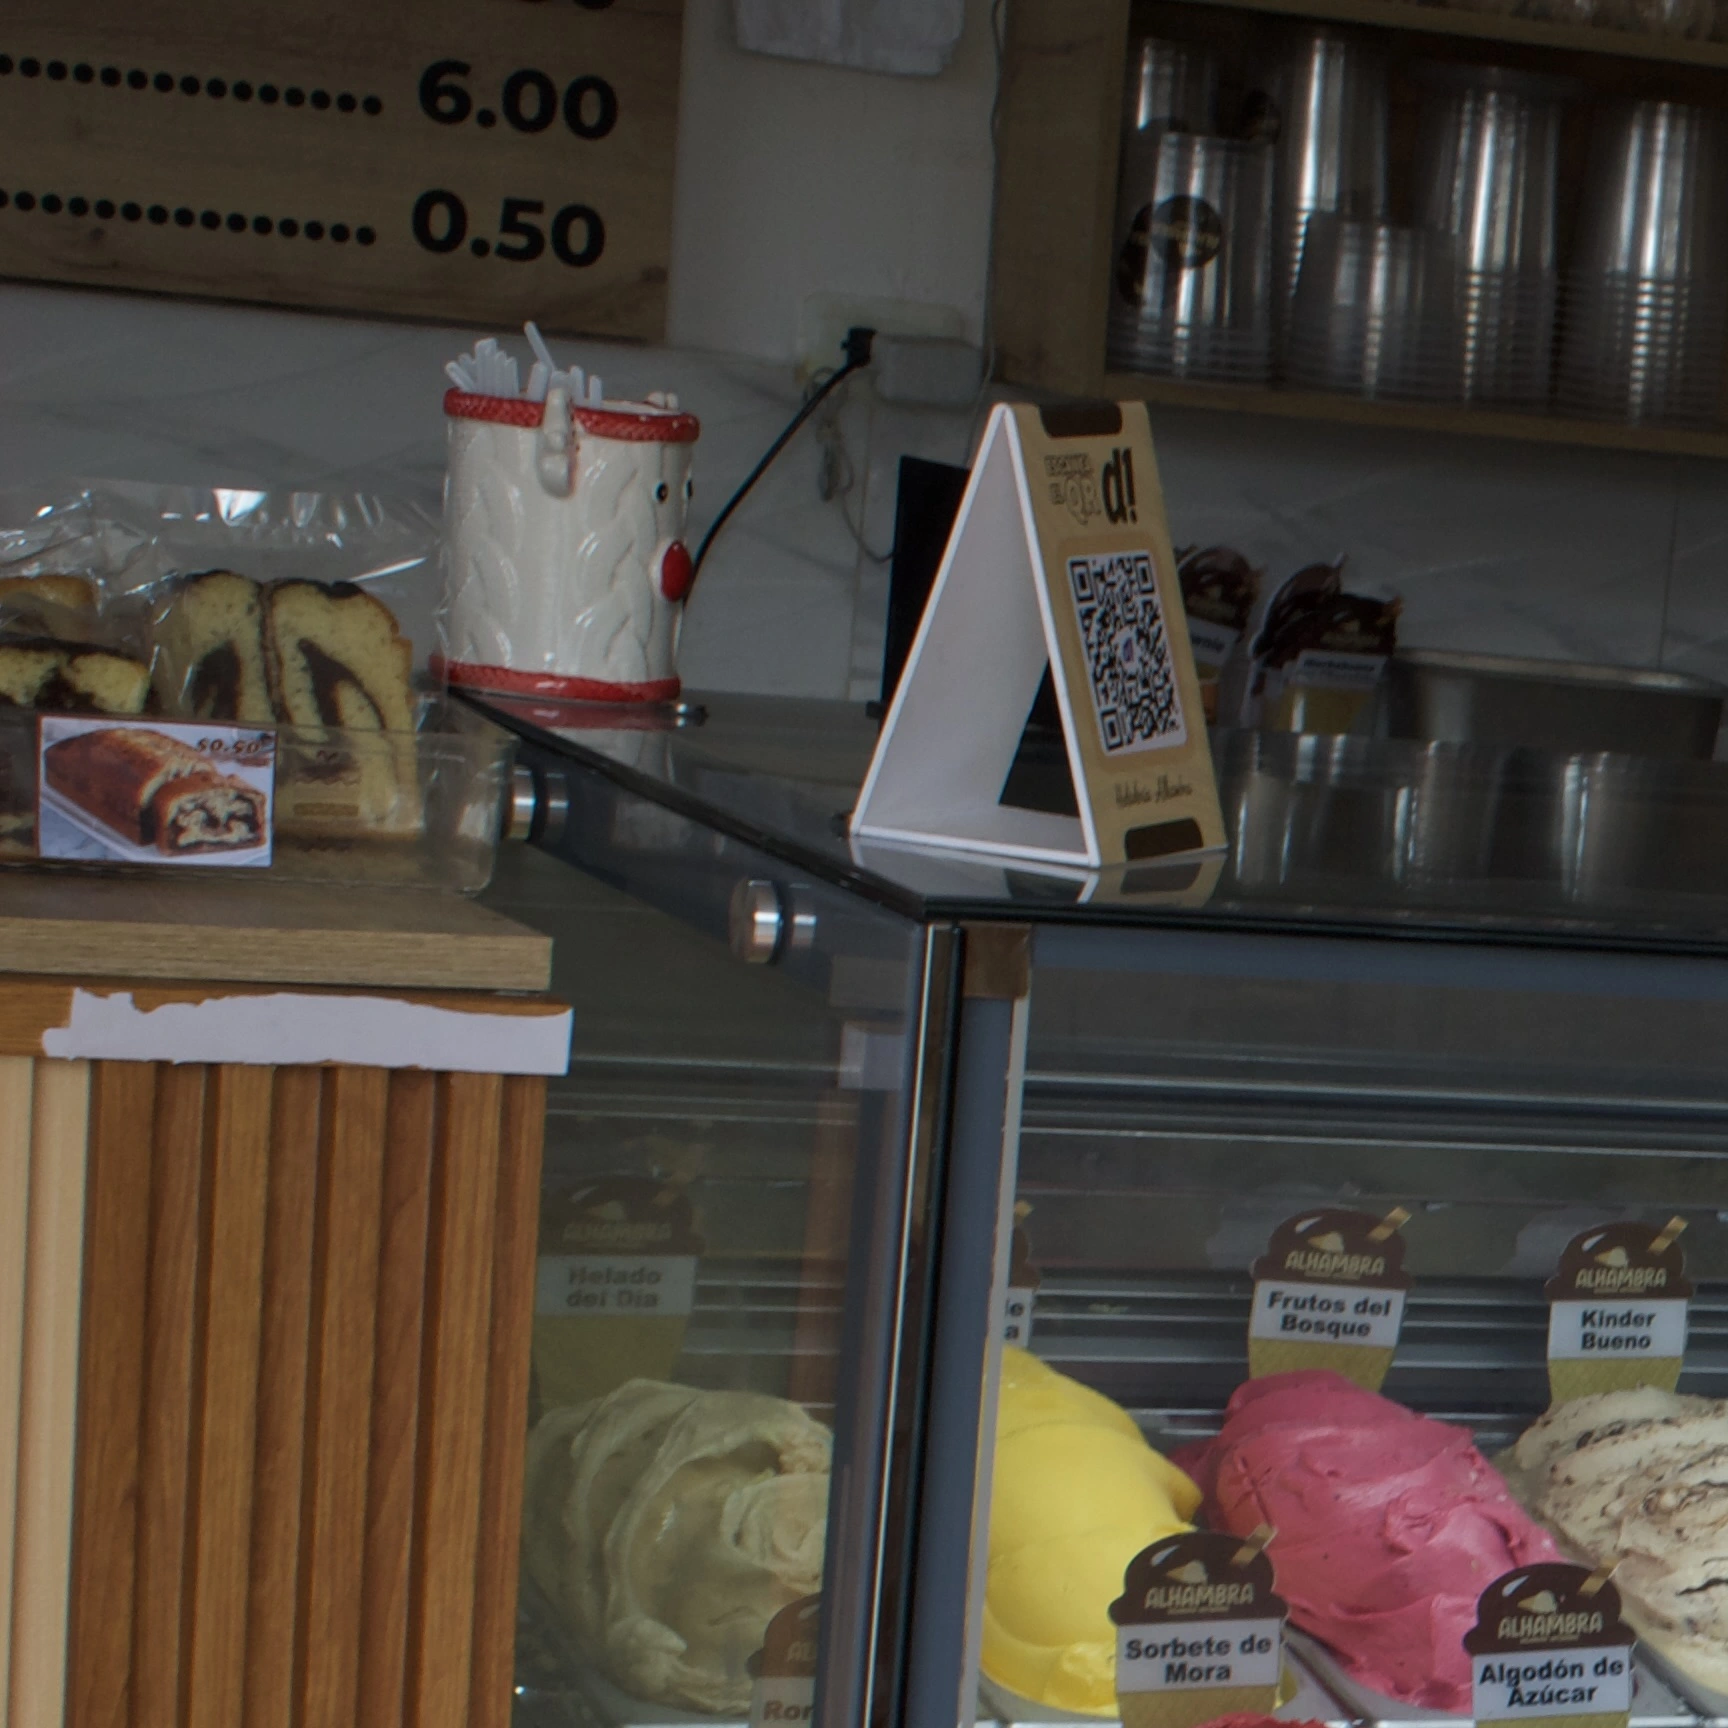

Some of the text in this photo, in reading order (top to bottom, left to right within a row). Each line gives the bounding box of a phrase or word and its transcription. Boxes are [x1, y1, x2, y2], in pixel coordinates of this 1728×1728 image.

[418, 60, 619, 141] 6.00
[411, 188, 605, 268] 0.50
[569, 1264, 663, 1285] Helado
[1285, 1249, 1386, 1276] ALHAMBRA
[1575, 1267, 1667, 1289] ALHAMBRA
[566, 1290, 606, 1309] del
[1267, 1291, 1392, 1316] Frutos del
[1280, 1314, 1372, 1339] Bosque
[1581, 1309, 1656, 1329] Kinder
[1581, 1333, 1652, 1351] Bueno
[1145, 1582, 1255, 1608] ALHAMBRA
[1497, 1611, 1604, 1640] ALHAMBRA
[1126, 1633, 1271, 1660] Sorbete de
[1164, 1661, 1232, 1684] Mora
[1479, 1656, 1624, 1688] Algodón de
[1507, 1683, 1599, 1708] Azúcar
